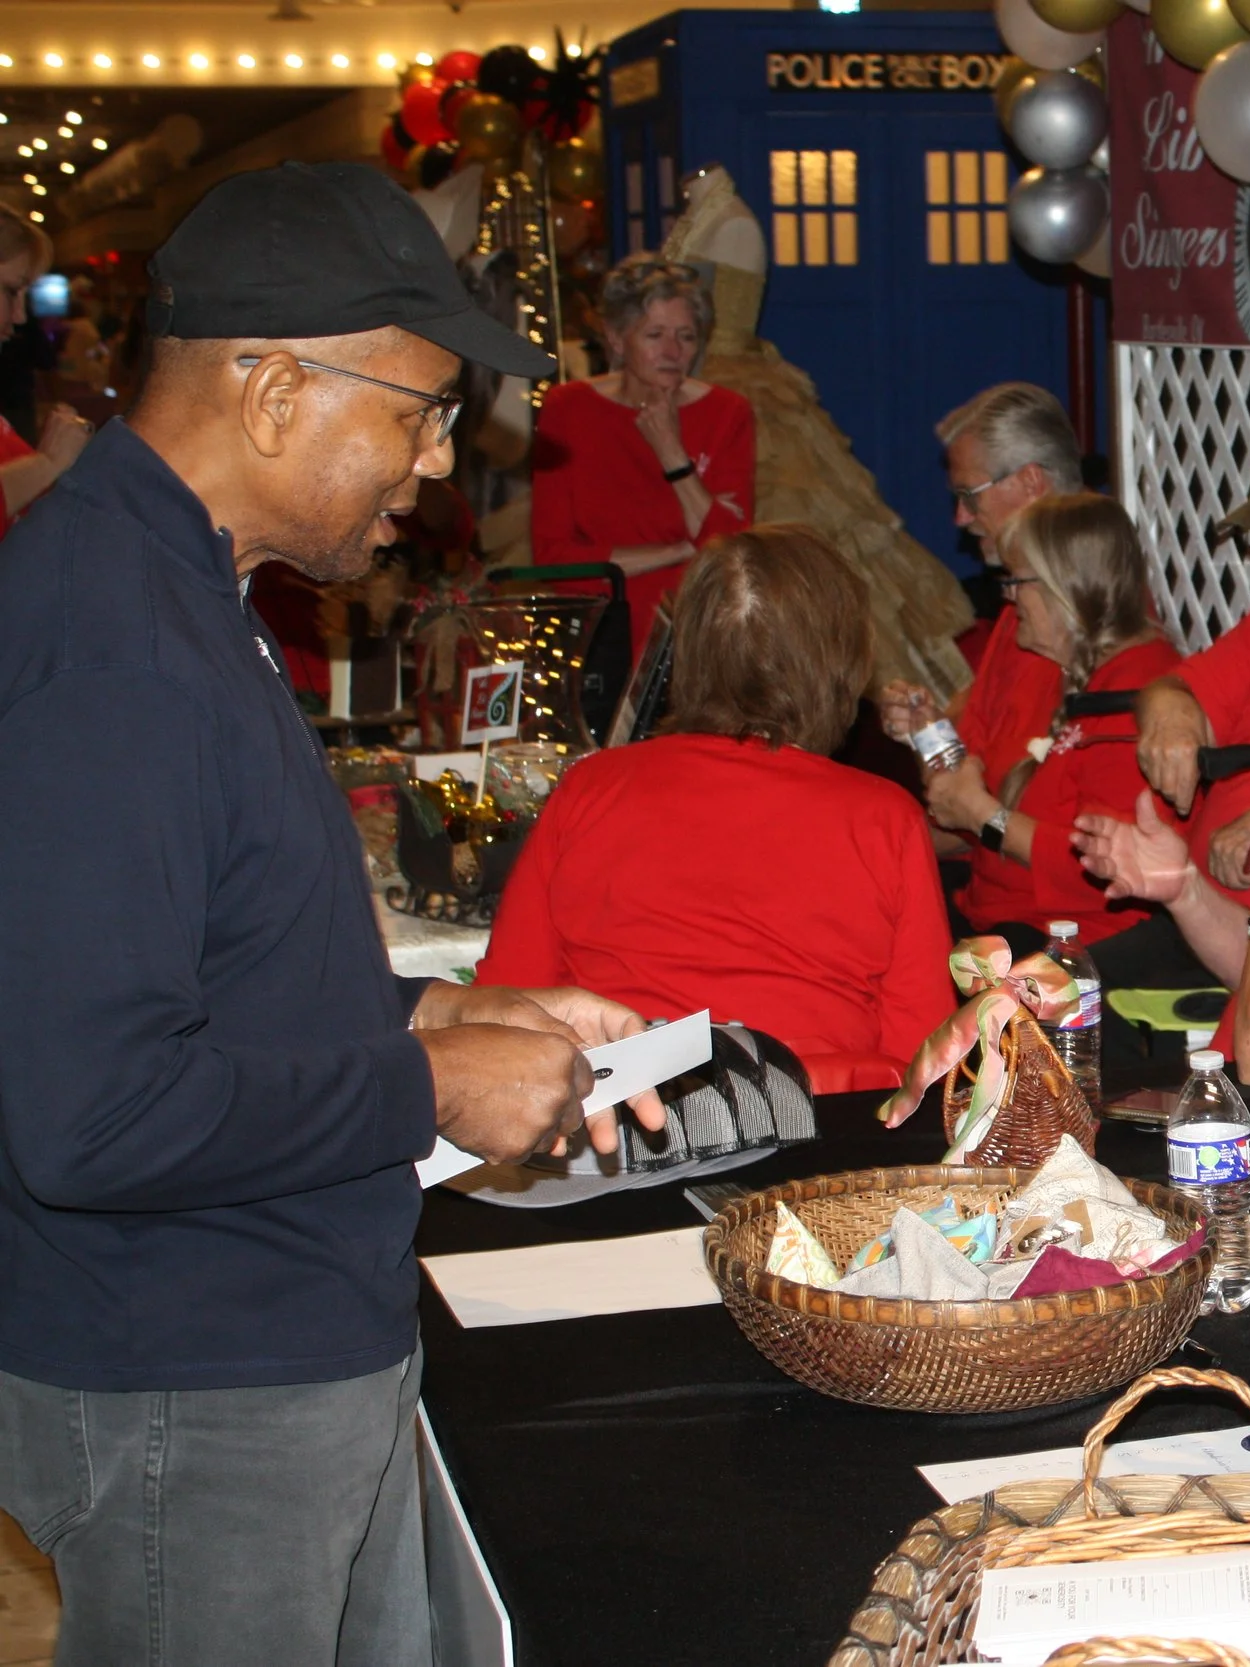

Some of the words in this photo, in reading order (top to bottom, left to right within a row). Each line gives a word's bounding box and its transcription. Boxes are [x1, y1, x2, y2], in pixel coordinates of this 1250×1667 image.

[766, 52, 884, 89] POLICE
[940, 54, 1006, 89] BOX
[1120, 191, 1229, 291] Singers
